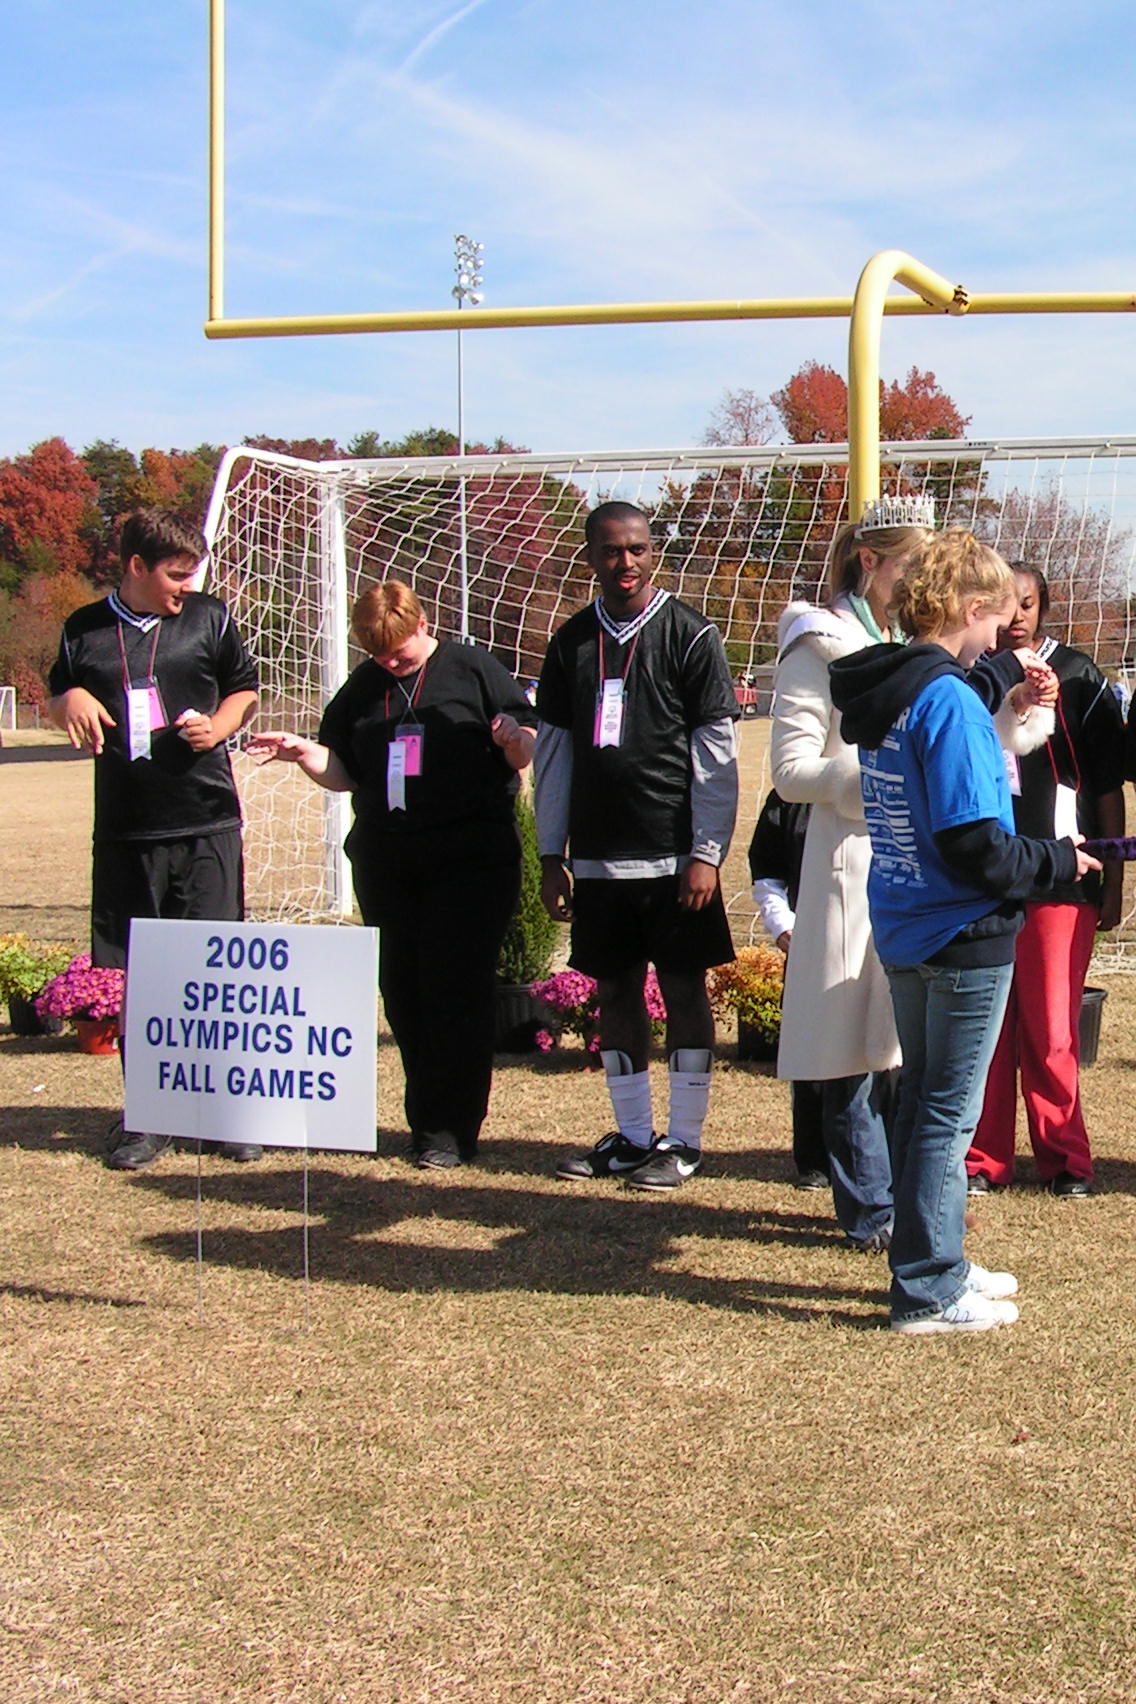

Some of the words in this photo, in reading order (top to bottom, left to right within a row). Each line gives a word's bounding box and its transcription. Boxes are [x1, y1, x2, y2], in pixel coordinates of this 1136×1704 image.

[205, 935, 289, 971] 2006
[183, 981, 306, 1017] SPECIAL
[145, 1016, 293, 1054] OLYMPICS
[307, 1025, 353, 1058] NC
[158, 1060, 216, 1094] FALL
[226, 1066, 337, 1101] GAMES
